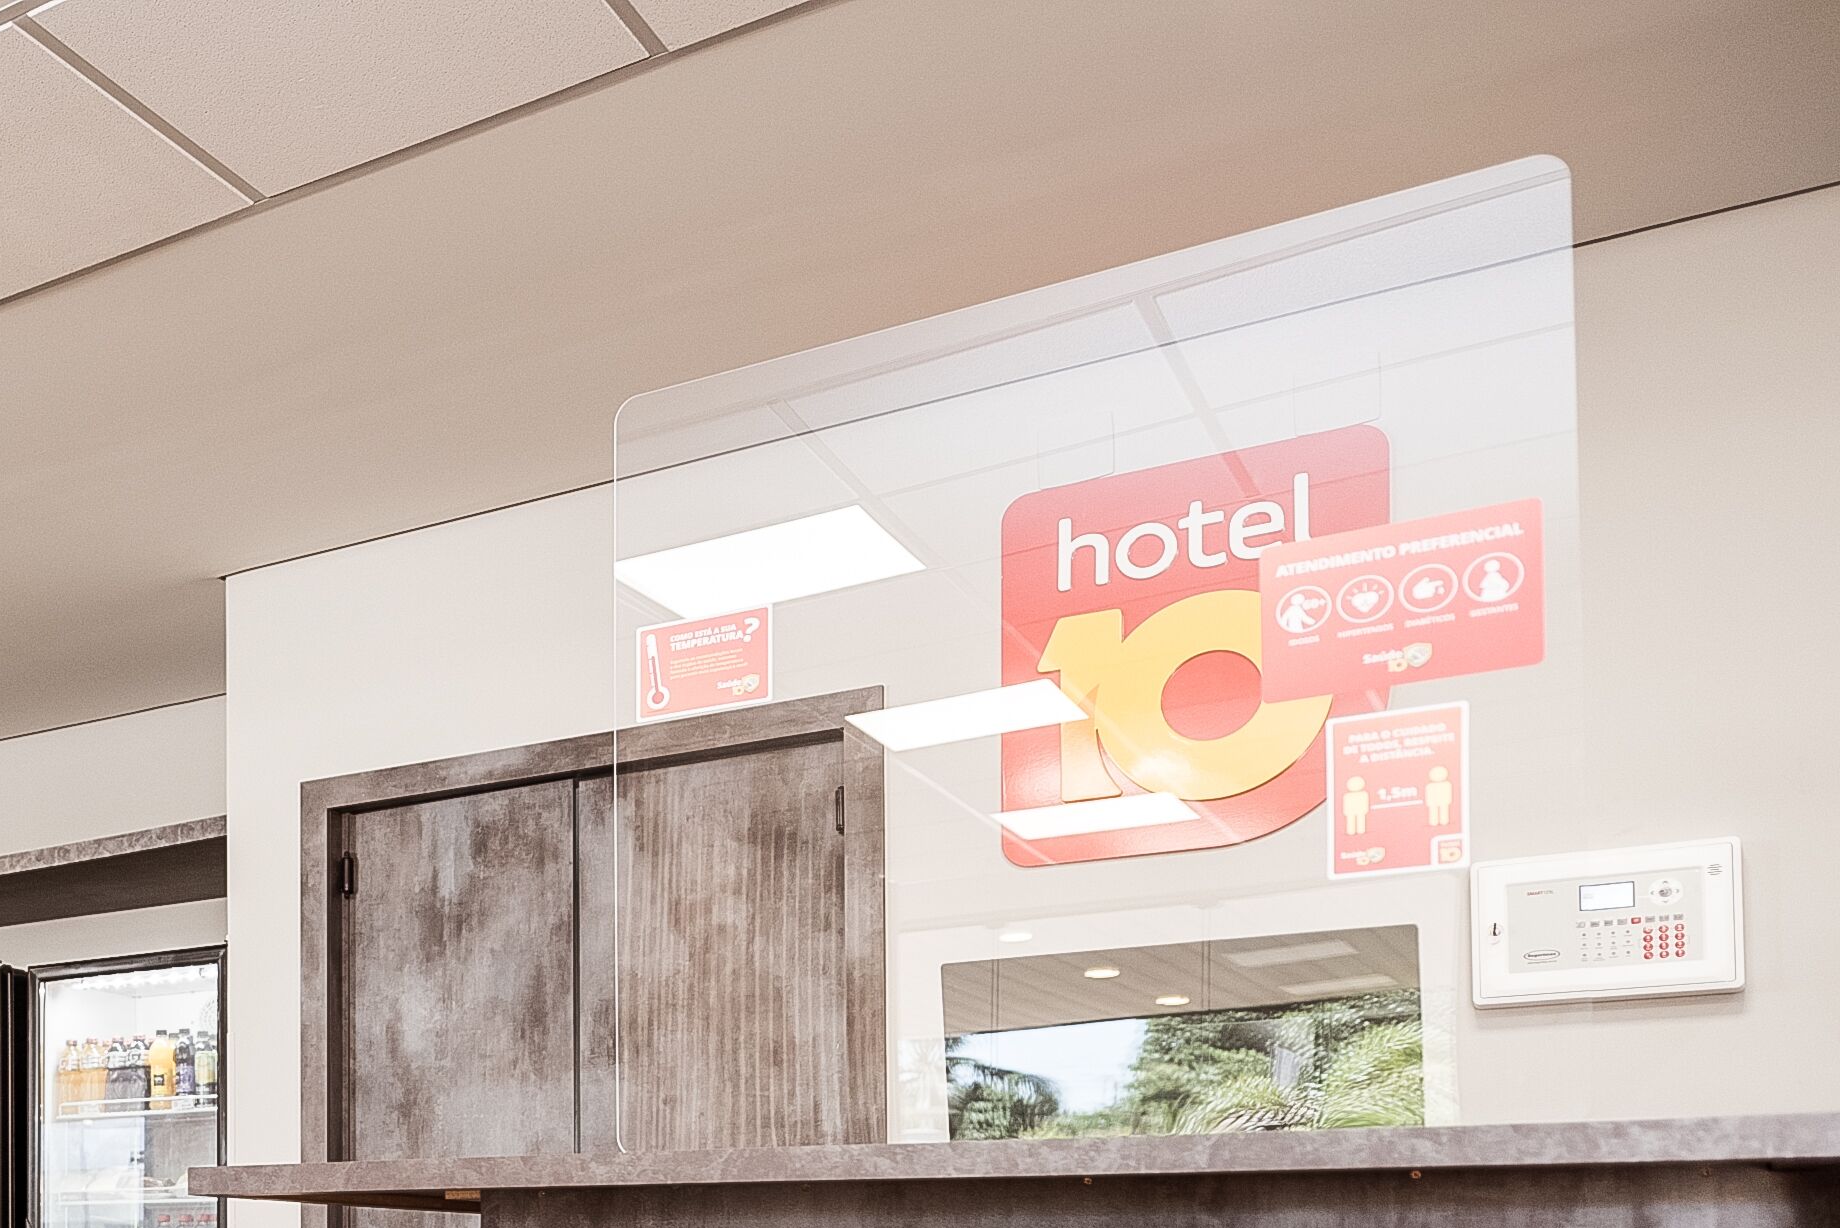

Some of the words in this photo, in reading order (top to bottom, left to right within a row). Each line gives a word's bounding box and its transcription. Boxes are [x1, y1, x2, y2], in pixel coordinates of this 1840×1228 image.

[1057, 473, 1310, 591] hotel
[1274, 546, 1396, 578] ATENDIMENTO
[1399, 523, 1524, 556] PREFERENCIAL
[670, 632, 693, 643] COMO
[695, 627, 712, 637] ESTÁ
[721, 624, 737, 632] SUA
[1036, 589, 1333, 803] 10
[1348, 732, 1379, 744] PARA
[1380, 729, 1391, 739] O
[1391, 723, 1447, 739] CUIDADO
[1378, 786, 1418, 801] 1,5m
